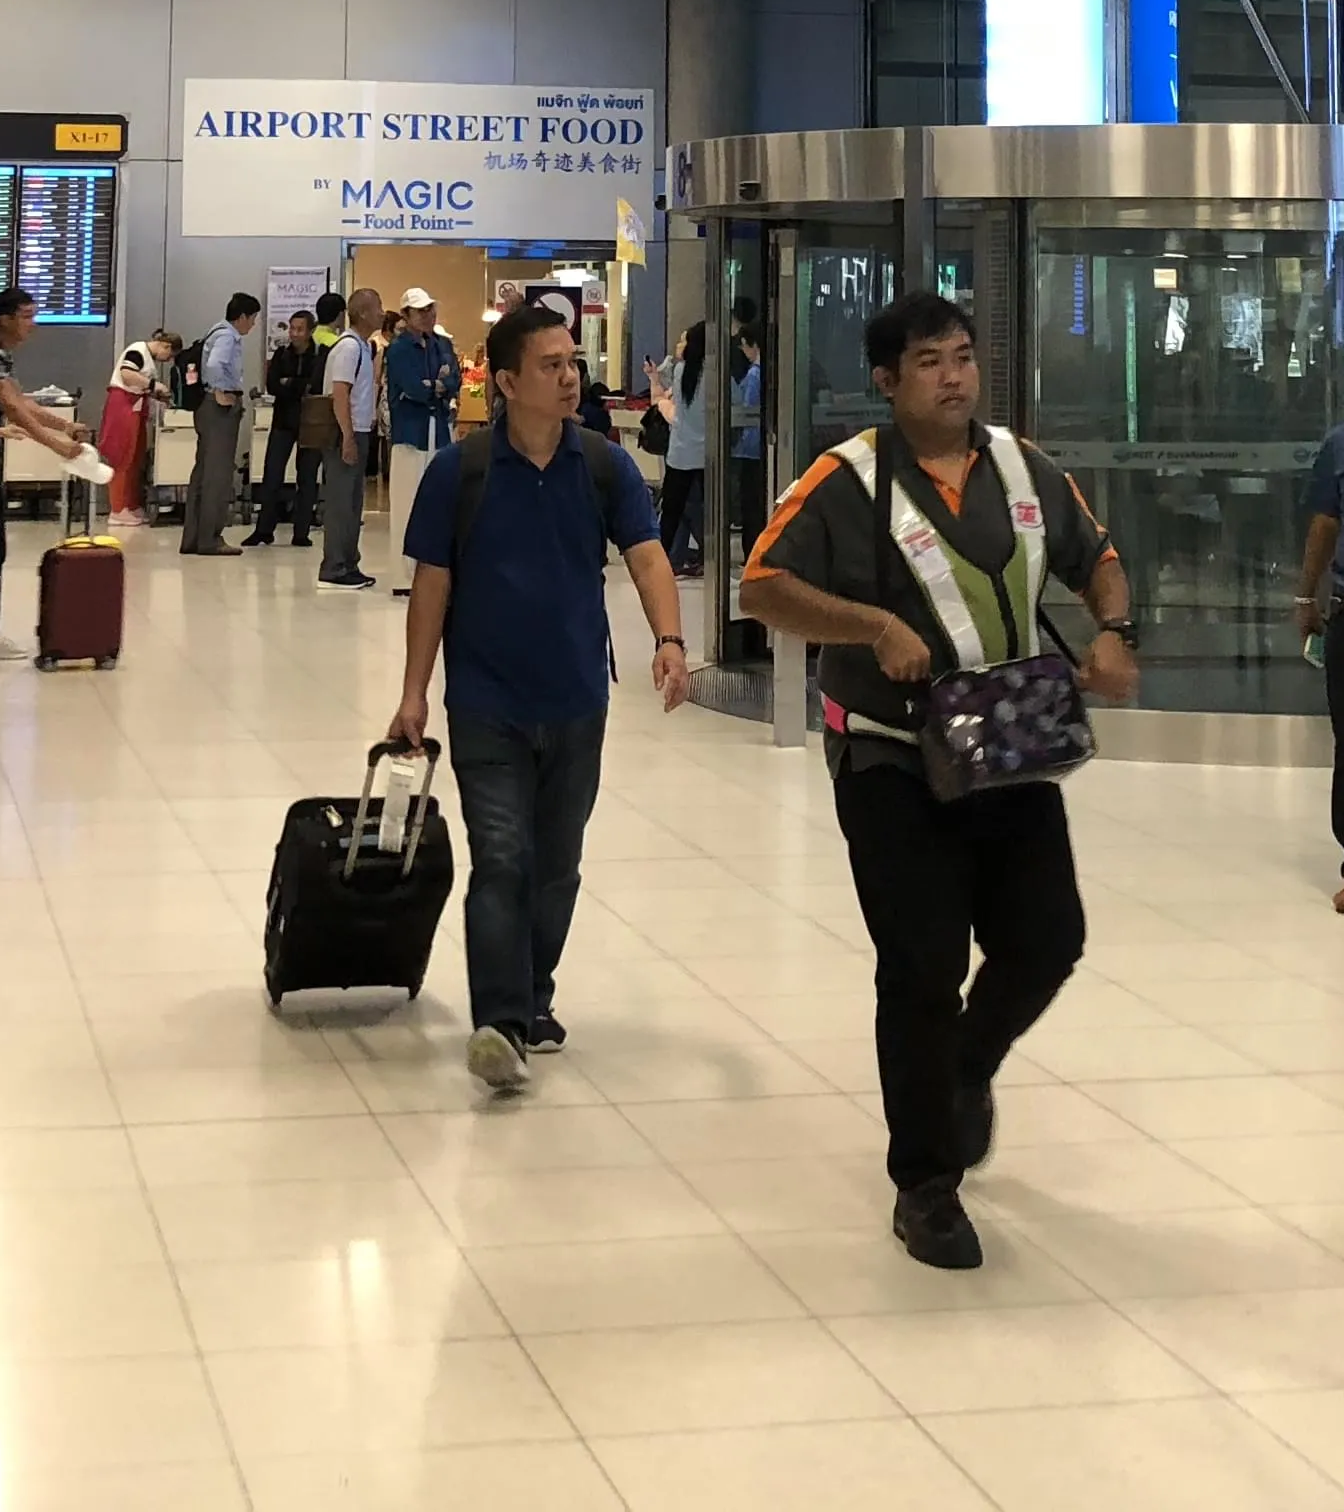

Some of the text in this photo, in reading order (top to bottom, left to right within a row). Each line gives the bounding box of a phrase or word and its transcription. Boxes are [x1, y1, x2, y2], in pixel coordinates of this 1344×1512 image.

[536, 94, 573, 108] แมจิก
[195, 110, 644, 145] AIRPORT STREET FOOD
[484, 150, 643, 176] 机场奇迹美食街
[313, 179, 330, 190] BY
[342, 179, 474, 210] MAGIC
[364, 213, 455, 231] Food Point
[276, 283, 318, 294] MAGIC
